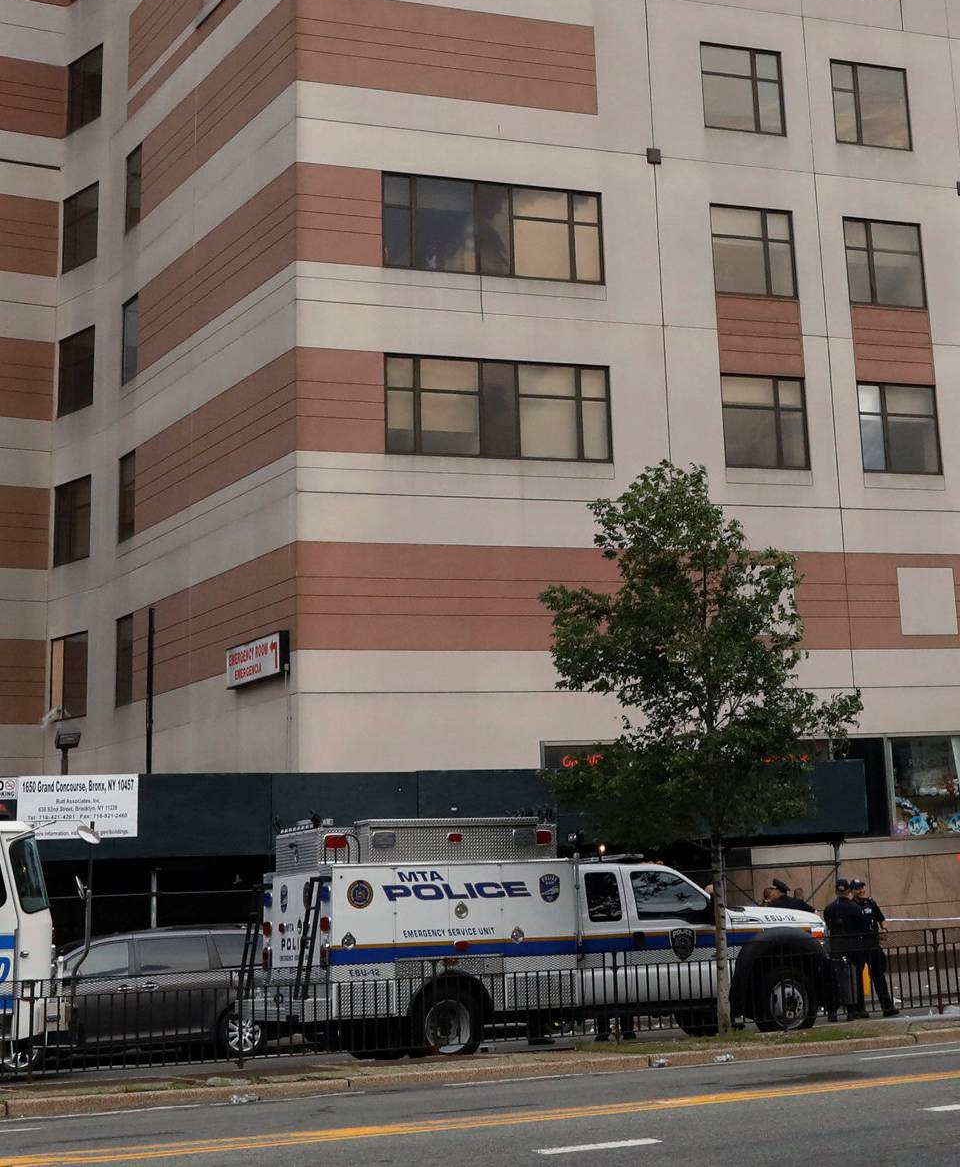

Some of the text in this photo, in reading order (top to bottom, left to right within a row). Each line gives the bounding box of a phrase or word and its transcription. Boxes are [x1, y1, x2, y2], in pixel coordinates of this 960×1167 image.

[229, 643, 269, 667] EMERGENCY ROOM
[22, 779, 134, 793] 1650 Grand Concourse, Bronx, NY 10457
[397, 870, 445, 883] MTA
[382, 881, 533, 901] POLICE
[403, 927, 496, 938] EMERGENCY SERVICE UNIT
[281, 937, 310, 951] POLIE
